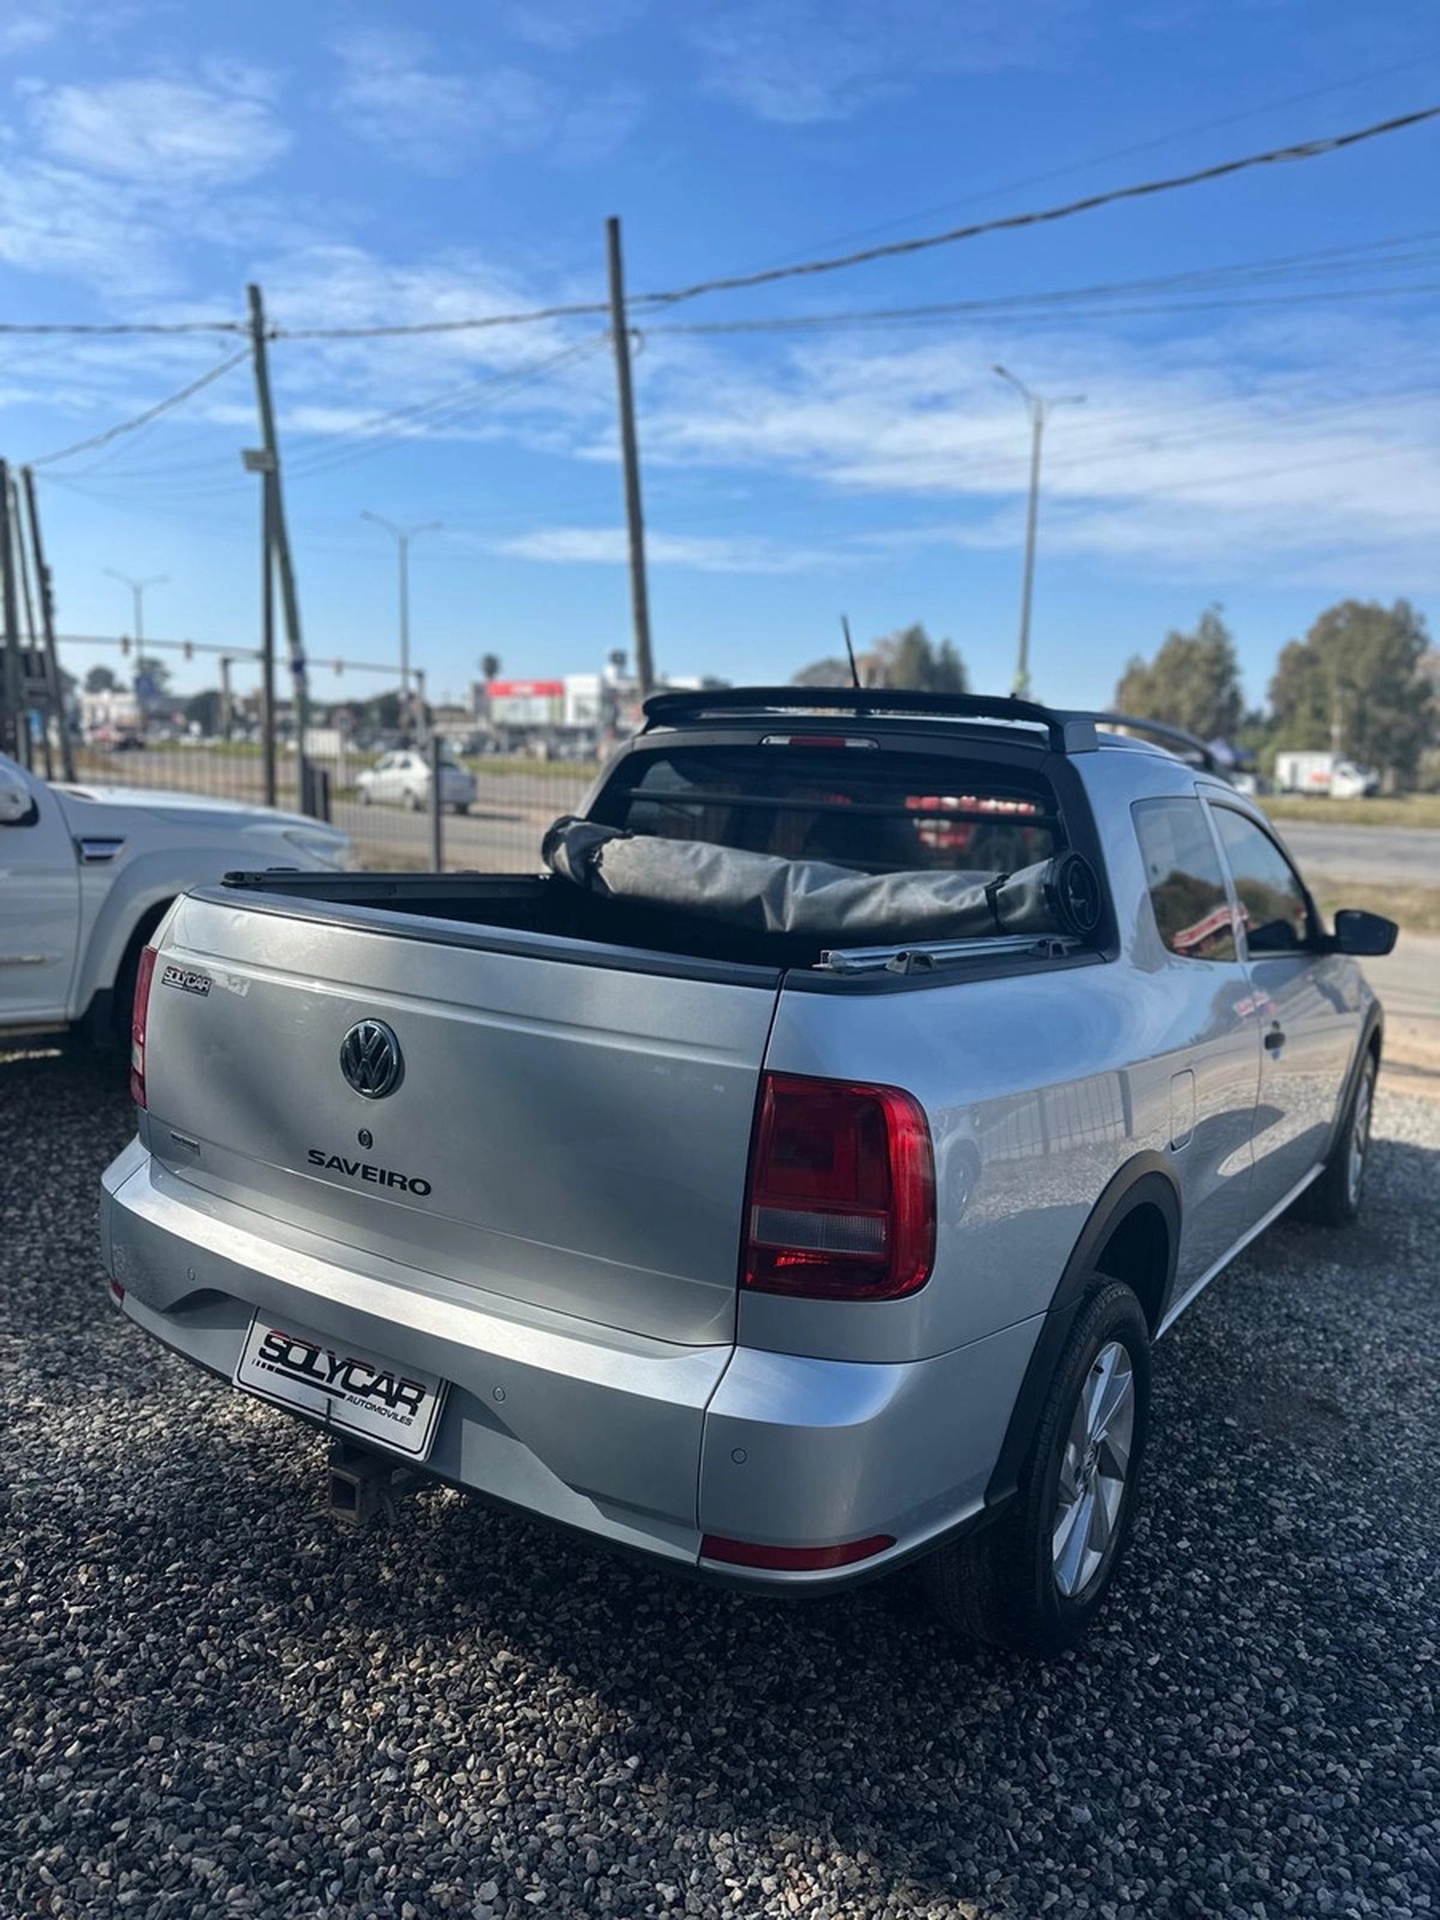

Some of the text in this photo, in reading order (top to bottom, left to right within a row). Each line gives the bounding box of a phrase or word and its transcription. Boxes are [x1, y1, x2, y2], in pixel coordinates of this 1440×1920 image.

[164, 969, 211, 992] SOLYCAR
[307, 1149, 432, 1197] SAVEIRO
[257, 1329, 427, 1416] SOLYCAR
[346, 1394, 414, 1427] AUTOMOVILES
